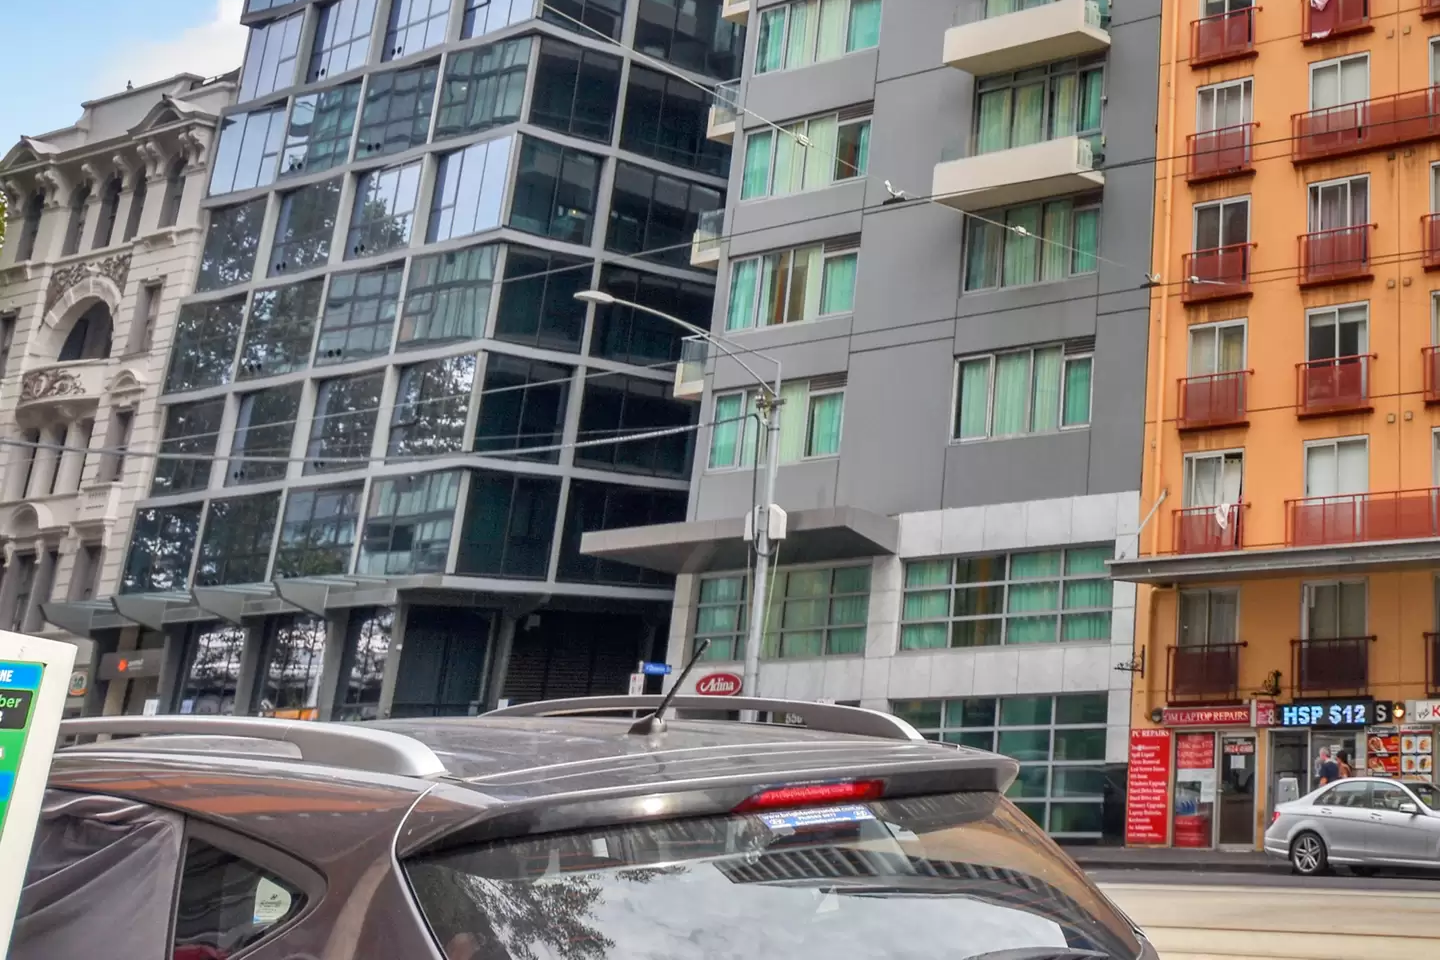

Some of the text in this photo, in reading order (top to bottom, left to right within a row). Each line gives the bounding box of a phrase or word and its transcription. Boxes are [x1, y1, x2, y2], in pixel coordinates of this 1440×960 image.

[0, 669, 14, 683] NE
[700, 677, 734, 693] Adina
[1179, 710, 1212, 721] LAPTOP
[1213, 709, 1248, 720] REPAIRS
[1283, 705, 1323, 725] HSP
[1328, 704, 1366, 724] $12
[1132, 730, 1141, 738] PC
